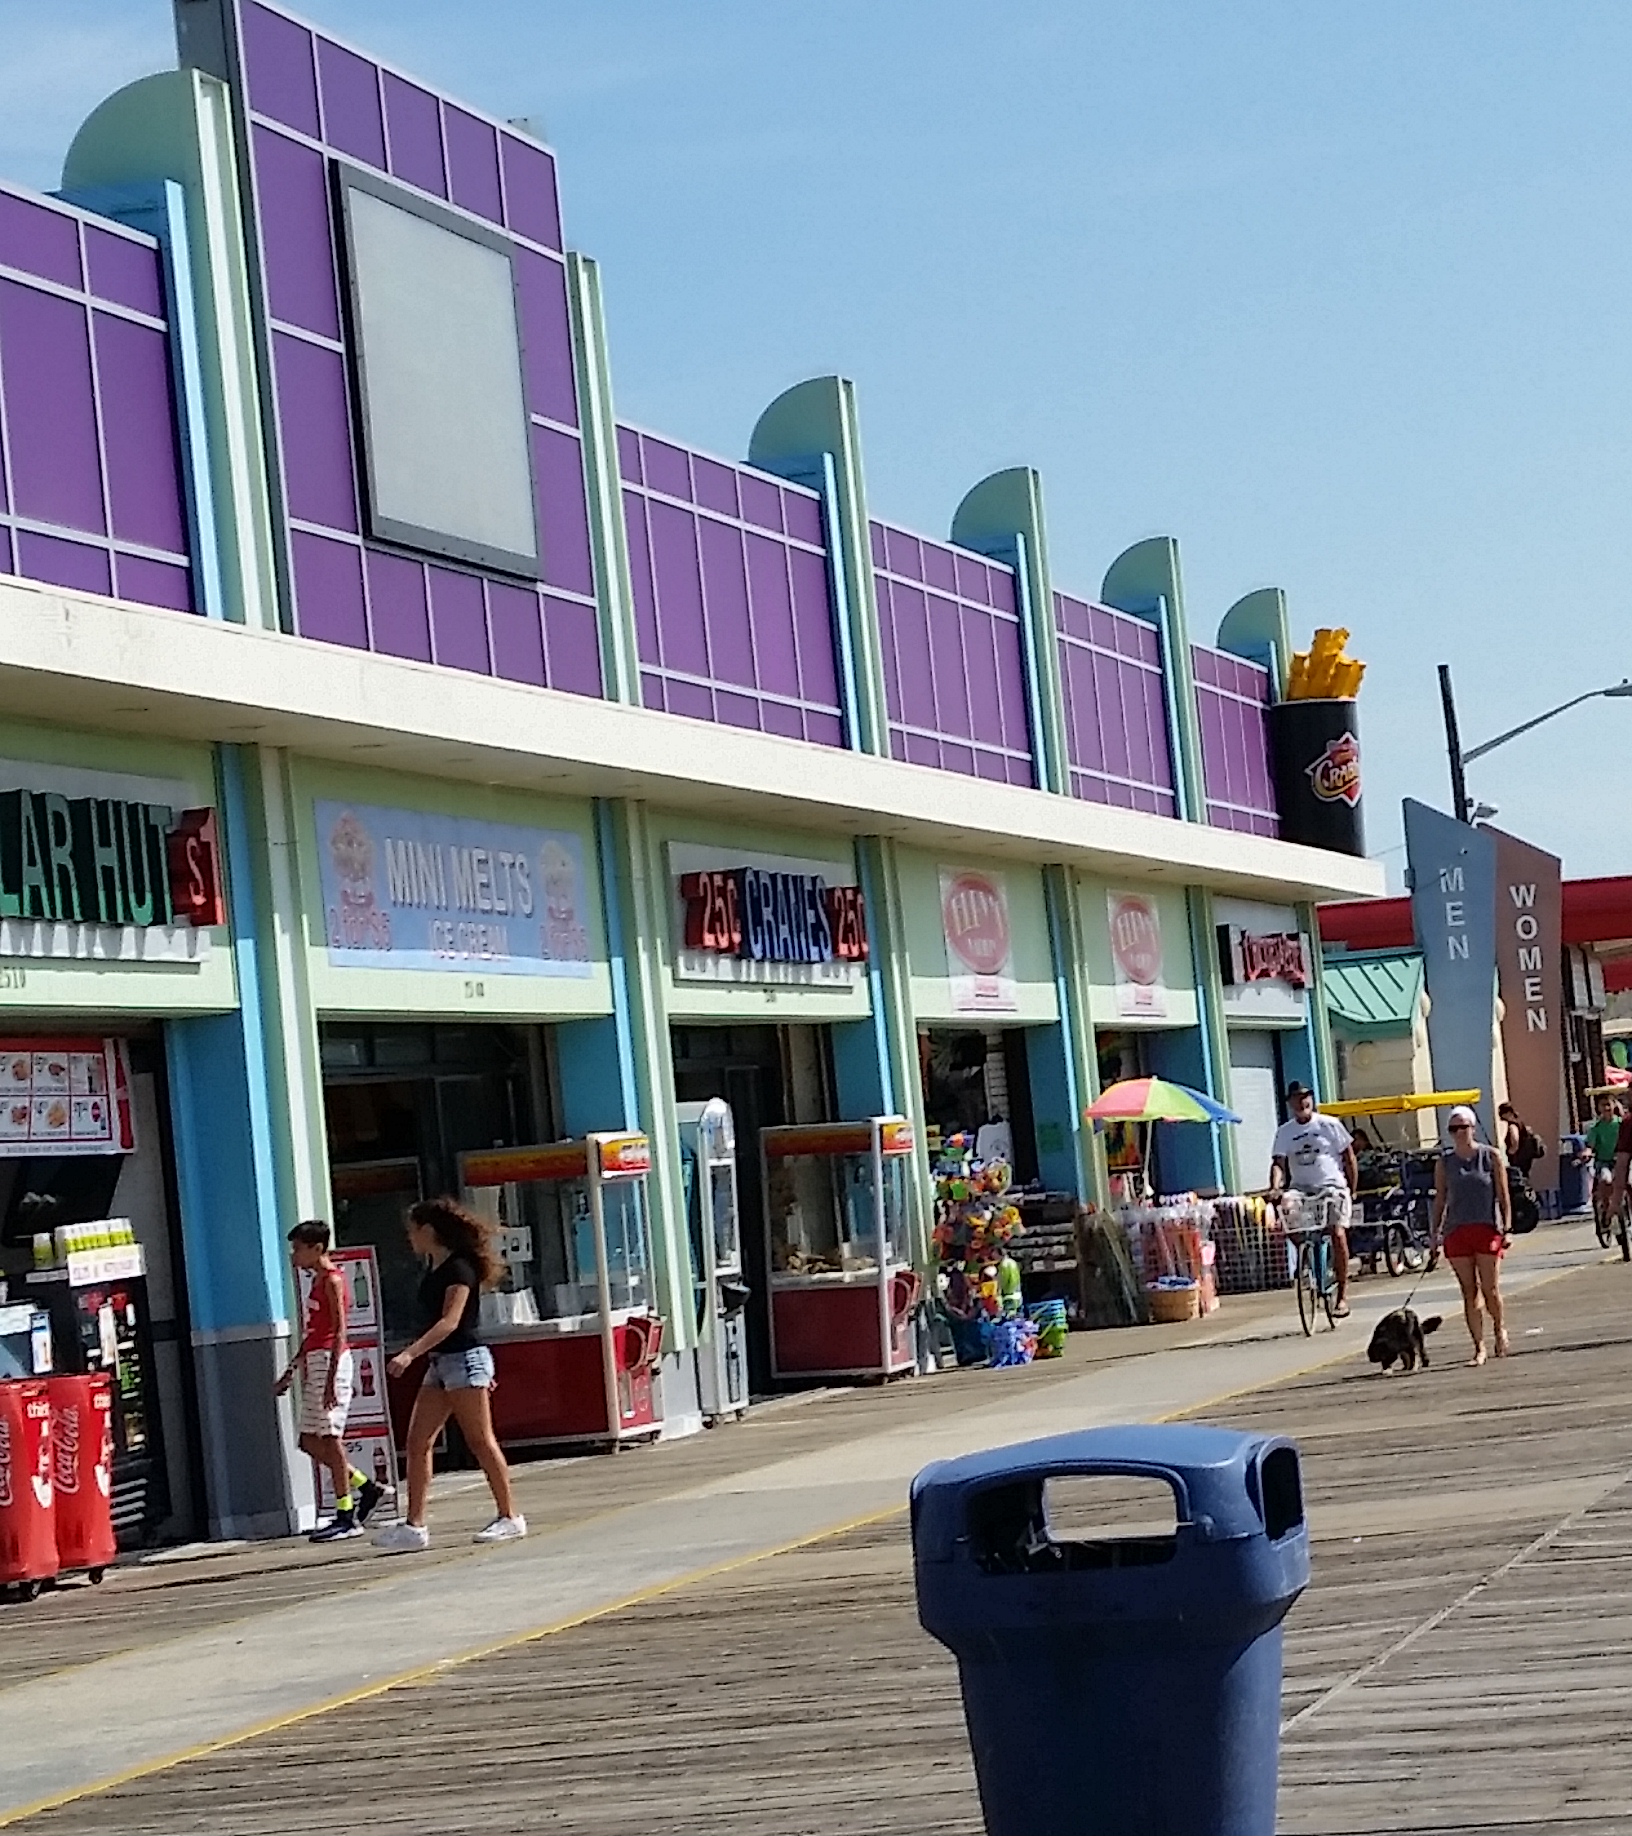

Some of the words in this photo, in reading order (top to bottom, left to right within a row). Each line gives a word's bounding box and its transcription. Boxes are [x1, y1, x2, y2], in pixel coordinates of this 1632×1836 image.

[90, 799, 174, 926] HUT
[385, 837, 449, 911] MINI
[450, 847, 534, 918] MELTS
[745, 867, 833, 961] CRANES
[1439, 867, 1470, 960] MEN
[1509, 883, 1548, 1032] WOMEN
